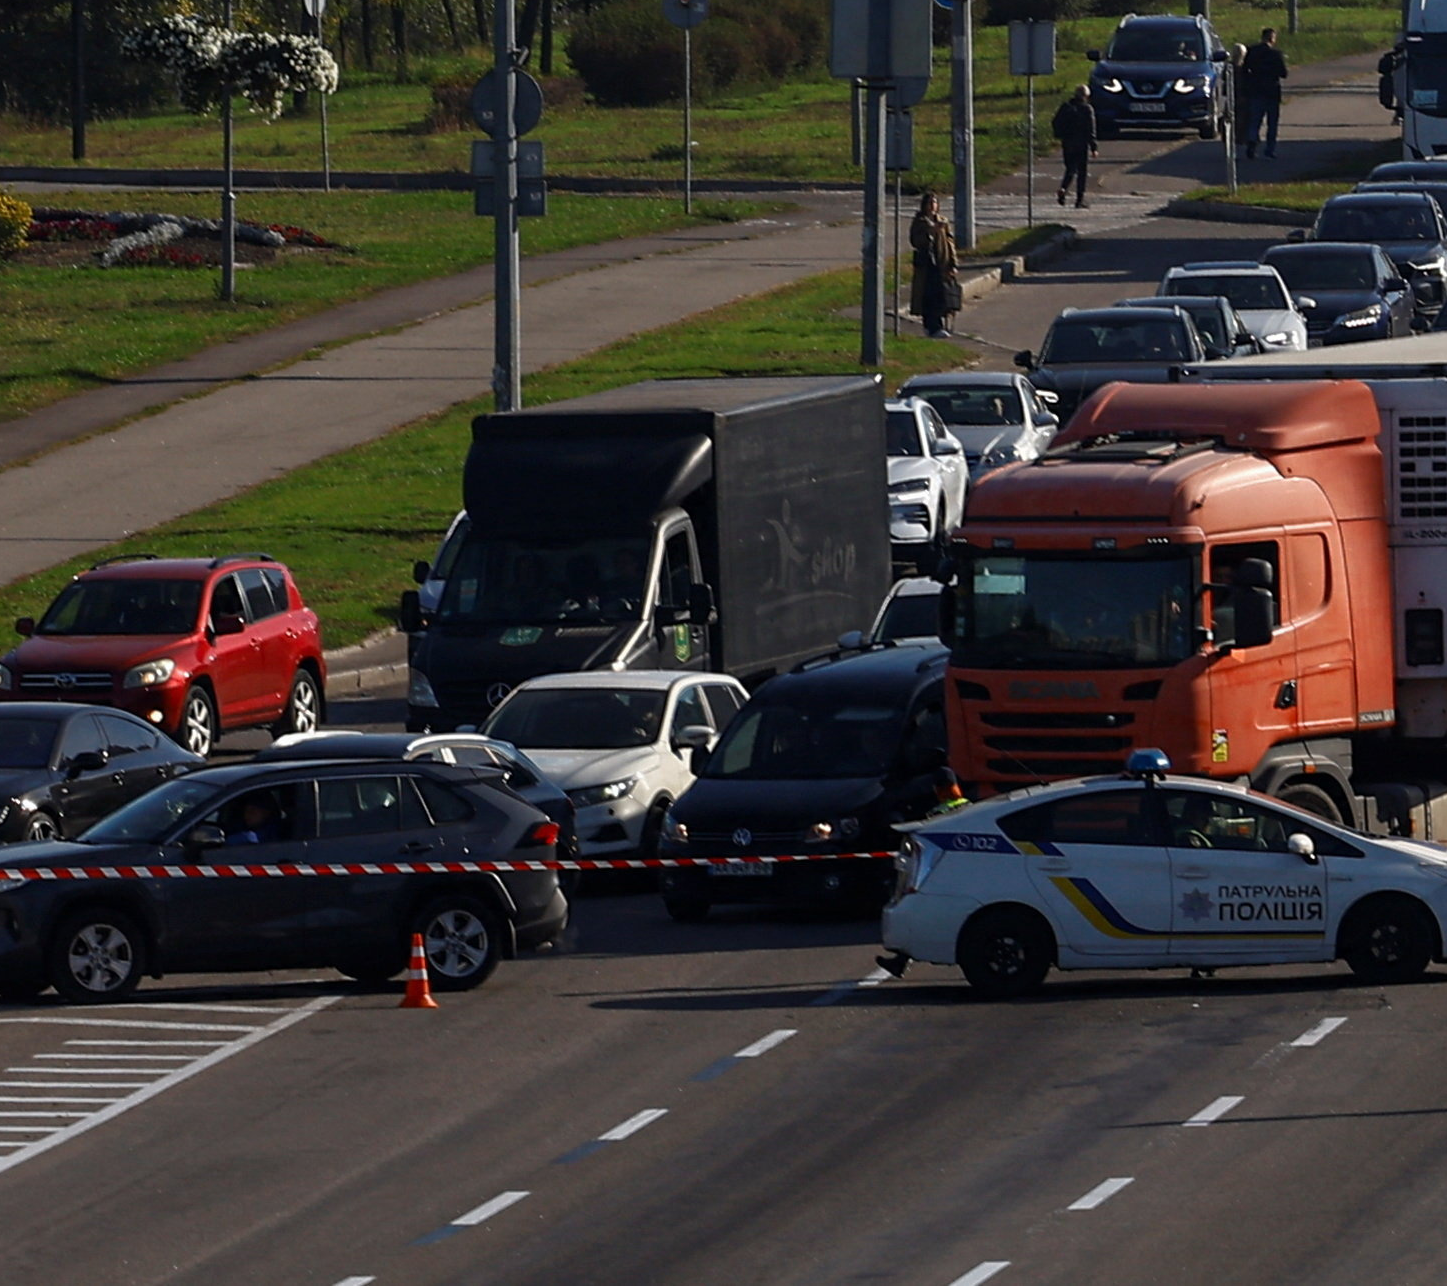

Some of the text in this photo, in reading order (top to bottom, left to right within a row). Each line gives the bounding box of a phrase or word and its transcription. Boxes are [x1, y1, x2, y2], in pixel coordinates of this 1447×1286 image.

[1009, 680, 1101, 699] SCANIA
[971, 833, 998, 852] 102
[1218, 885, 1322, 899] ПАТРУЛЬНА
[1218, 902, 1323, 922] ПОЛІЦІЯ
